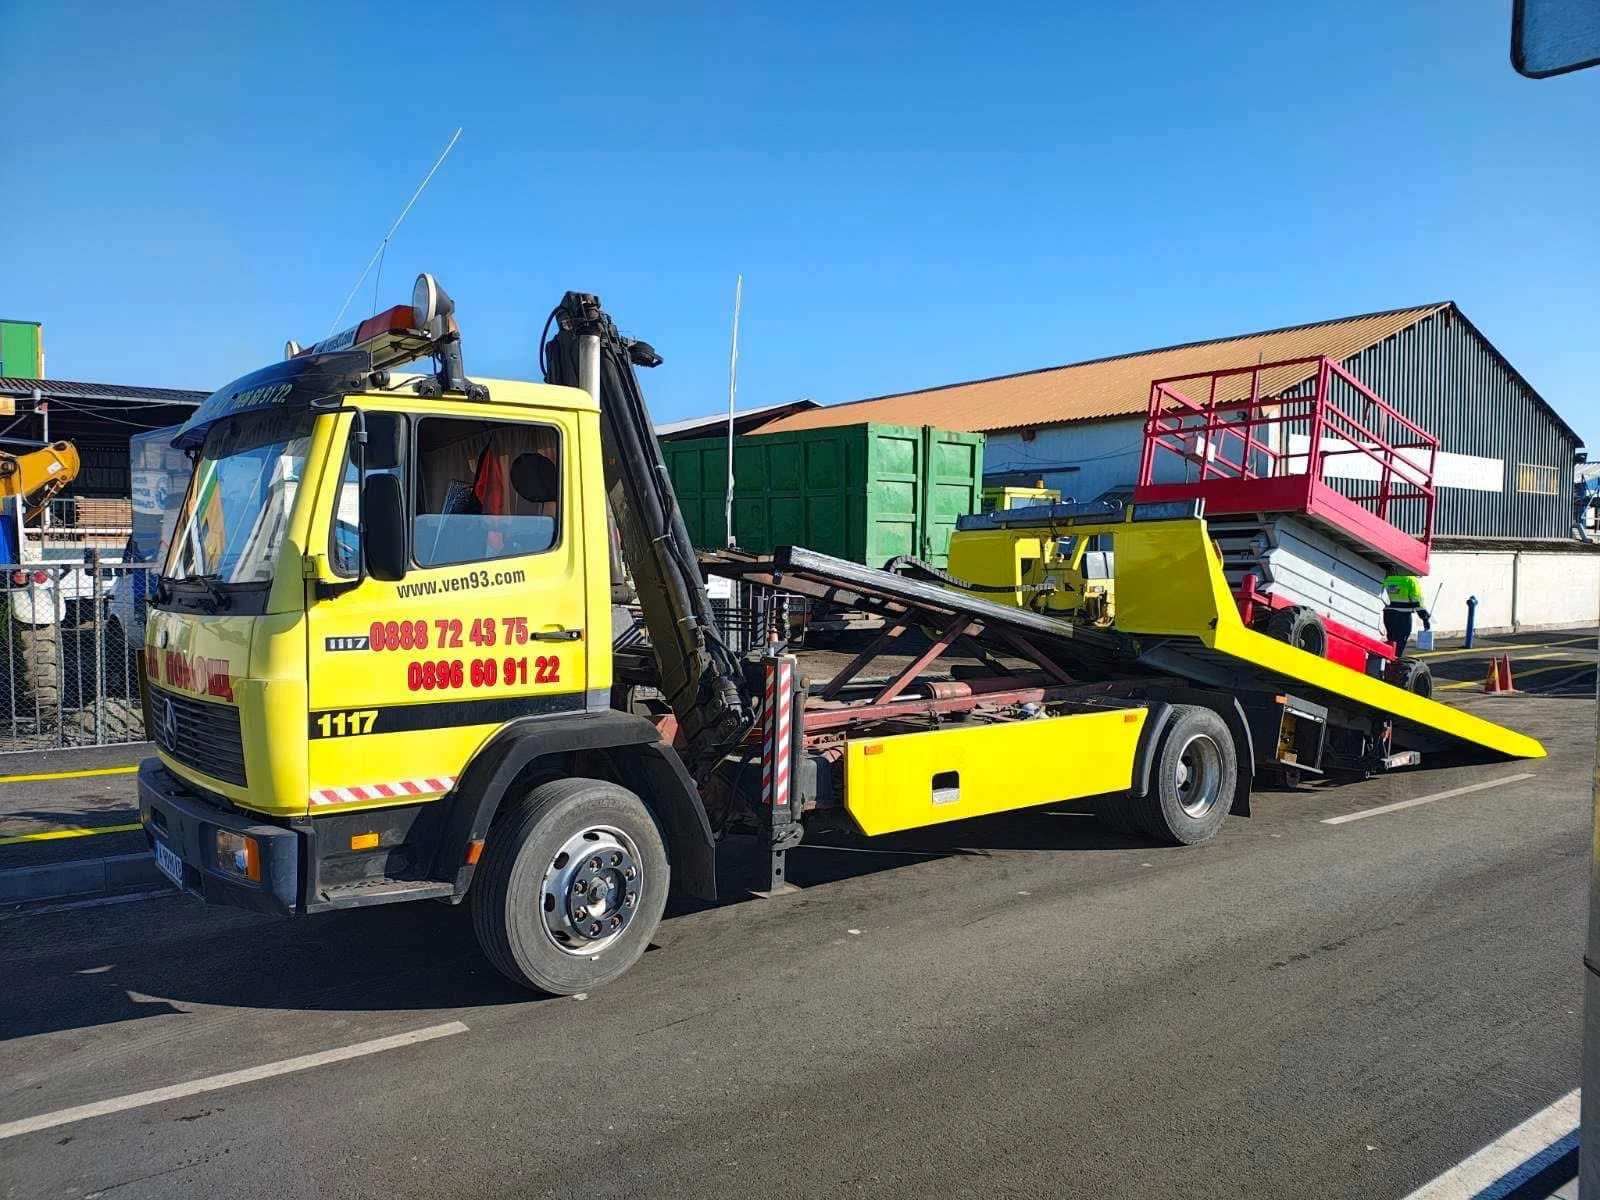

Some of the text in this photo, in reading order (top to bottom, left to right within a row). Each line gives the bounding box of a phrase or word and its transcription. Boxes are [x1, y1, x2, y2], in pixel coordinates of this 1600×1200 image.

[272, 383, 293, 404] 22
[397, 569, 526, 598] www.ven93.com
[328, 638, 368, 650] 1117
[370, 617, 528, 652] 0888 72 43 75
[408, 655, 560, 691] 0896 60 91 22
[318, 710, 379, 737] 1117
